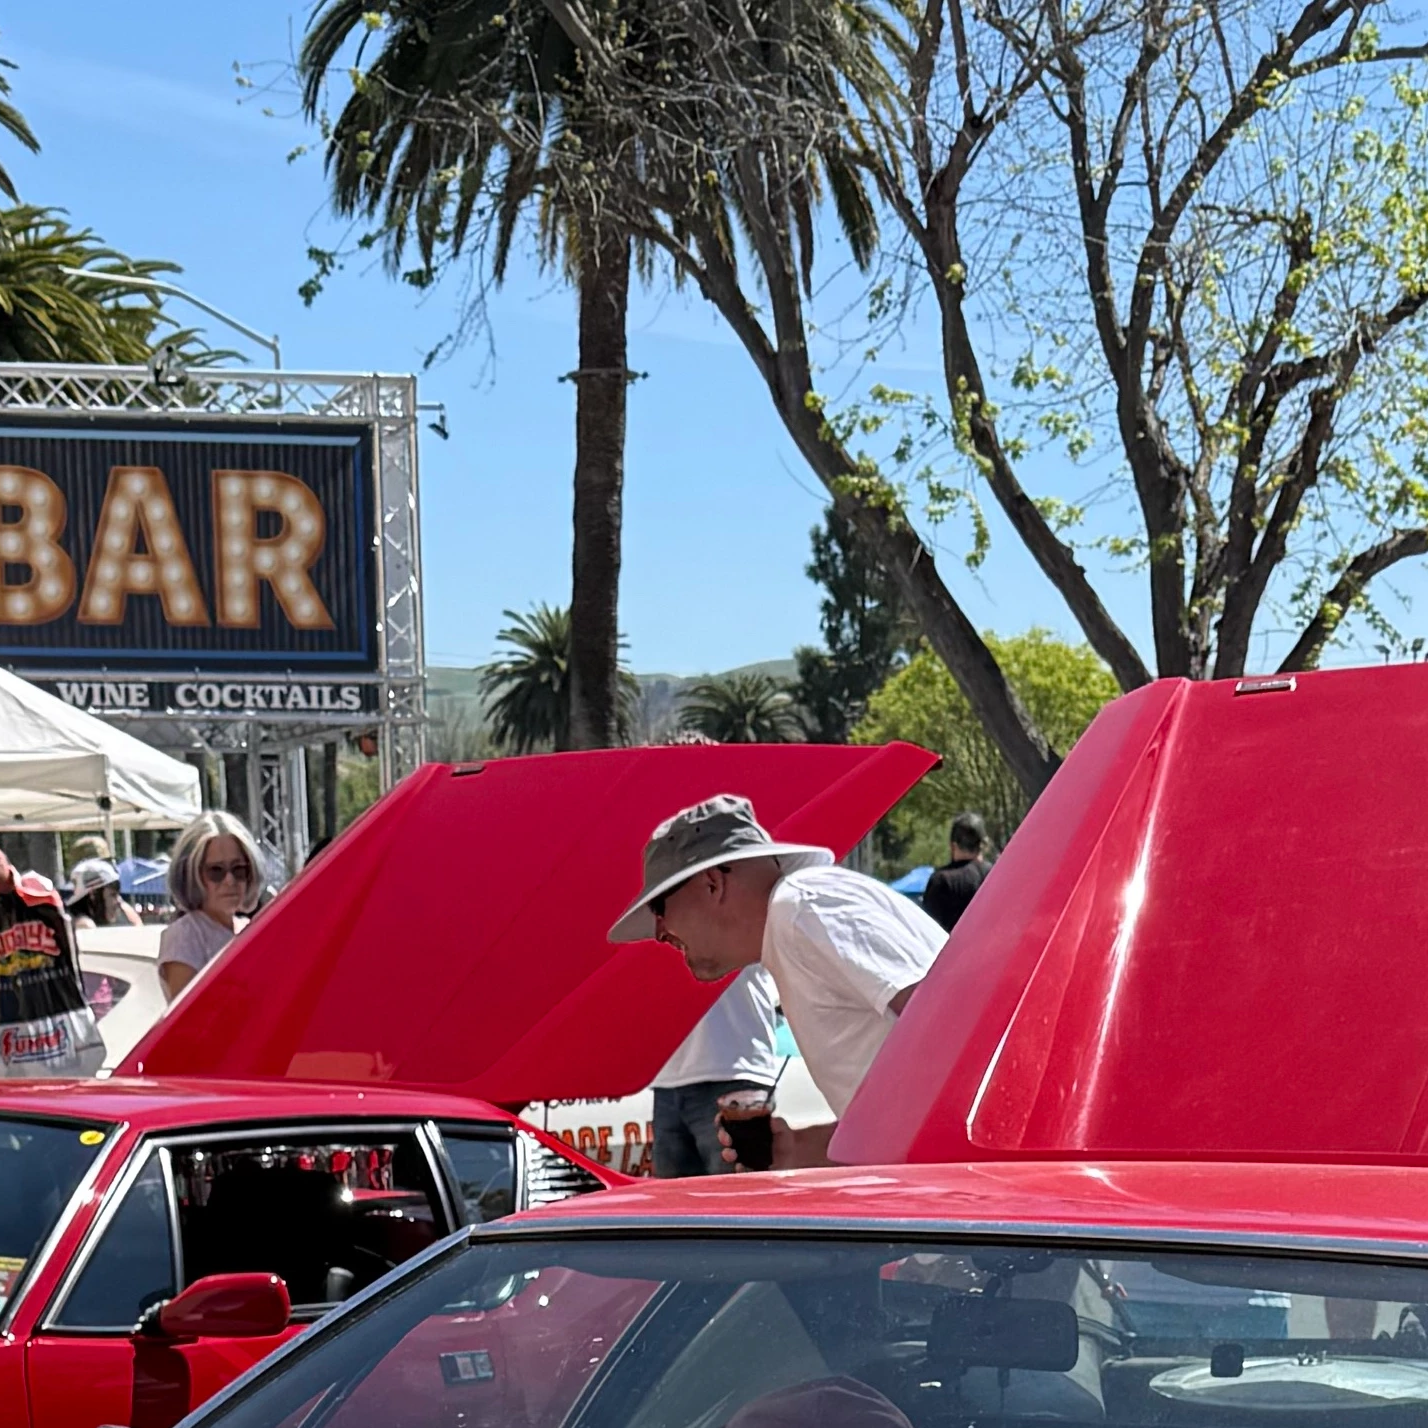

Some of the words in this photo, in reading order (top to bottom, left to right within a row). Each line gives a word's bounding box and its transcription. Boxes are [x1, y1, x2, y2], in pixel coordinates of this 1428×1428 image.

[56, 682, 150, 707] WINE
[175, 683, 362, 710] COCKTAILS
[550, 1125, 614, 1164] ACE
